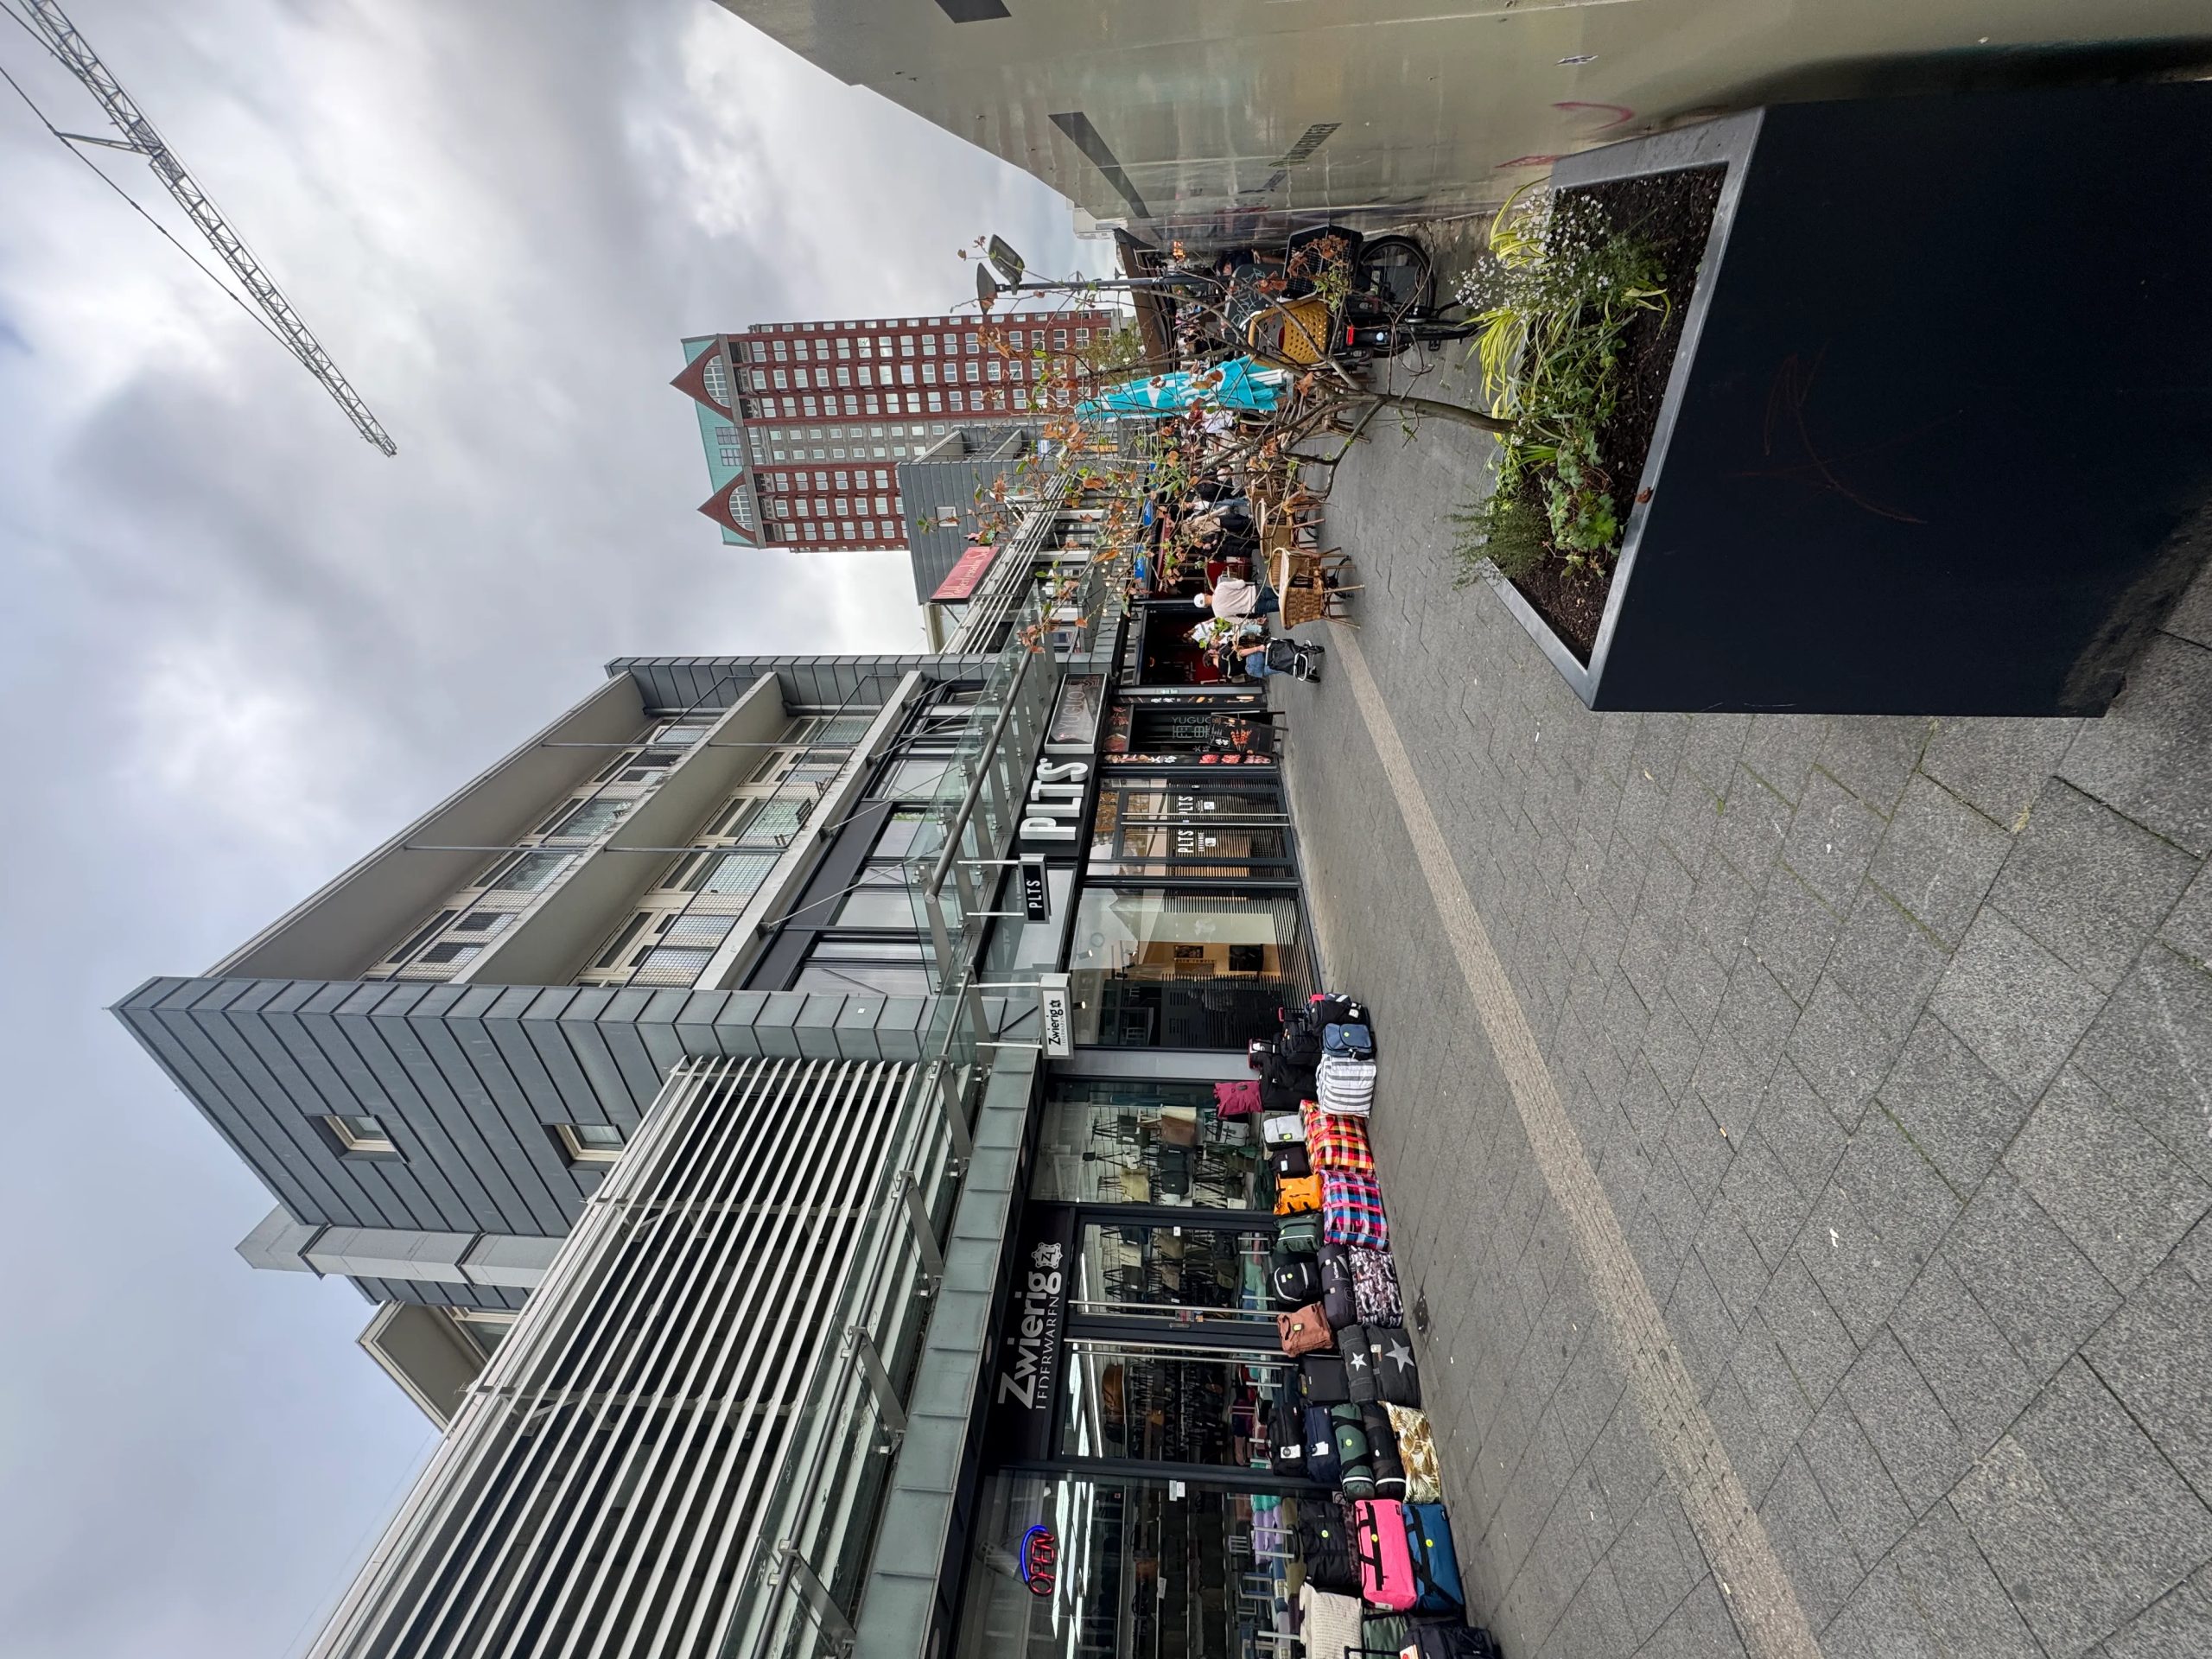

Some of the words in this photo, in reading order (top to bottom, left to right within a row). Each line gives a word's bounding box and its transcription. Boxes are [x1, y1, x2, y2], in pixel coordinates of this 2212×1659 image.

[1058, 691, 1085, 729] YUGUO
[1046, 1009, 1063, 1046] Zwierig
[997, 1271, 1062, 1409] Zwierig
[1028, 1531, 1056, 1597] OPEN
